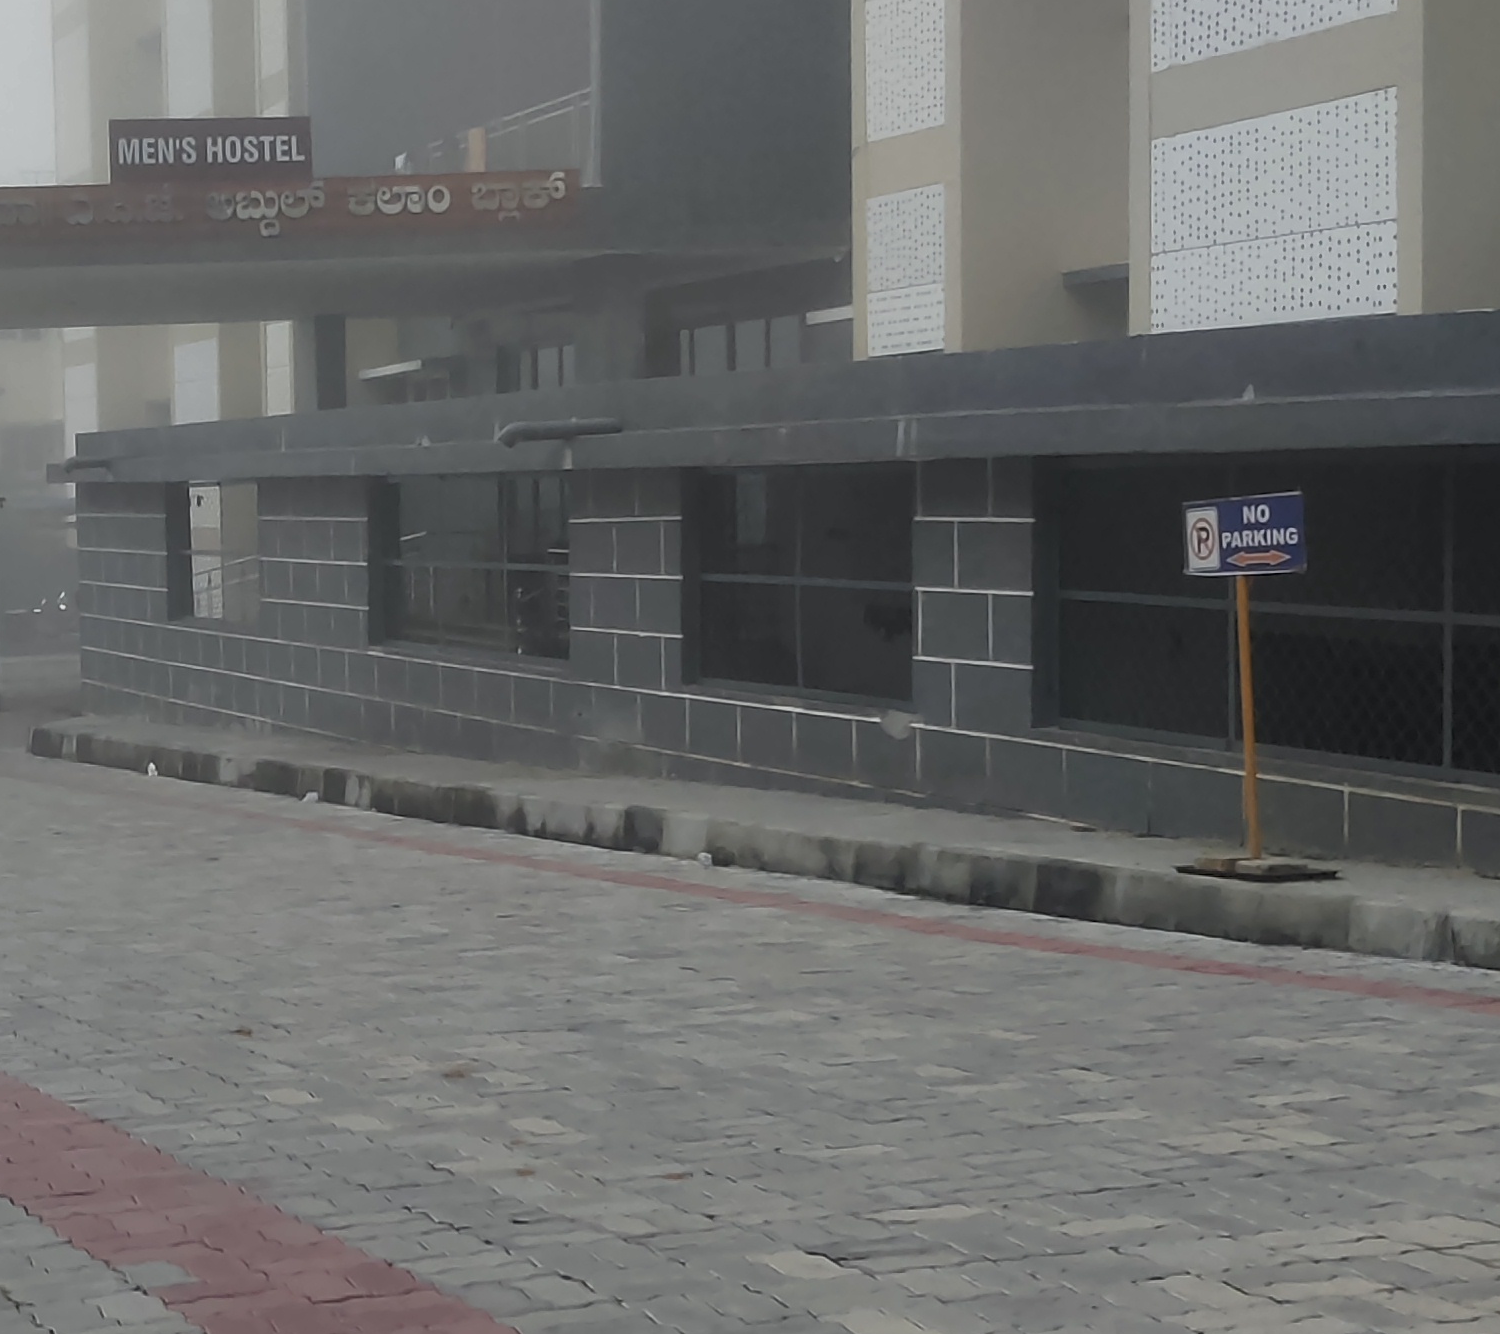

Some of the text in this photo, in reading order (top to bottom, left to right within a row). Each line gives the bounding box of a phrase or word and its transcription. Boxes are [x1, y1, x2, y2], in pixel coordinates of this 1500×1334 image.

[118, 135, 305, 165] MEN'S HOSTEL
[347, 179, 451, 216] ಕಲಾಂ
[1242, 504, 1270, 524] NO
[1221, 527, 1298, 549] PARKING
